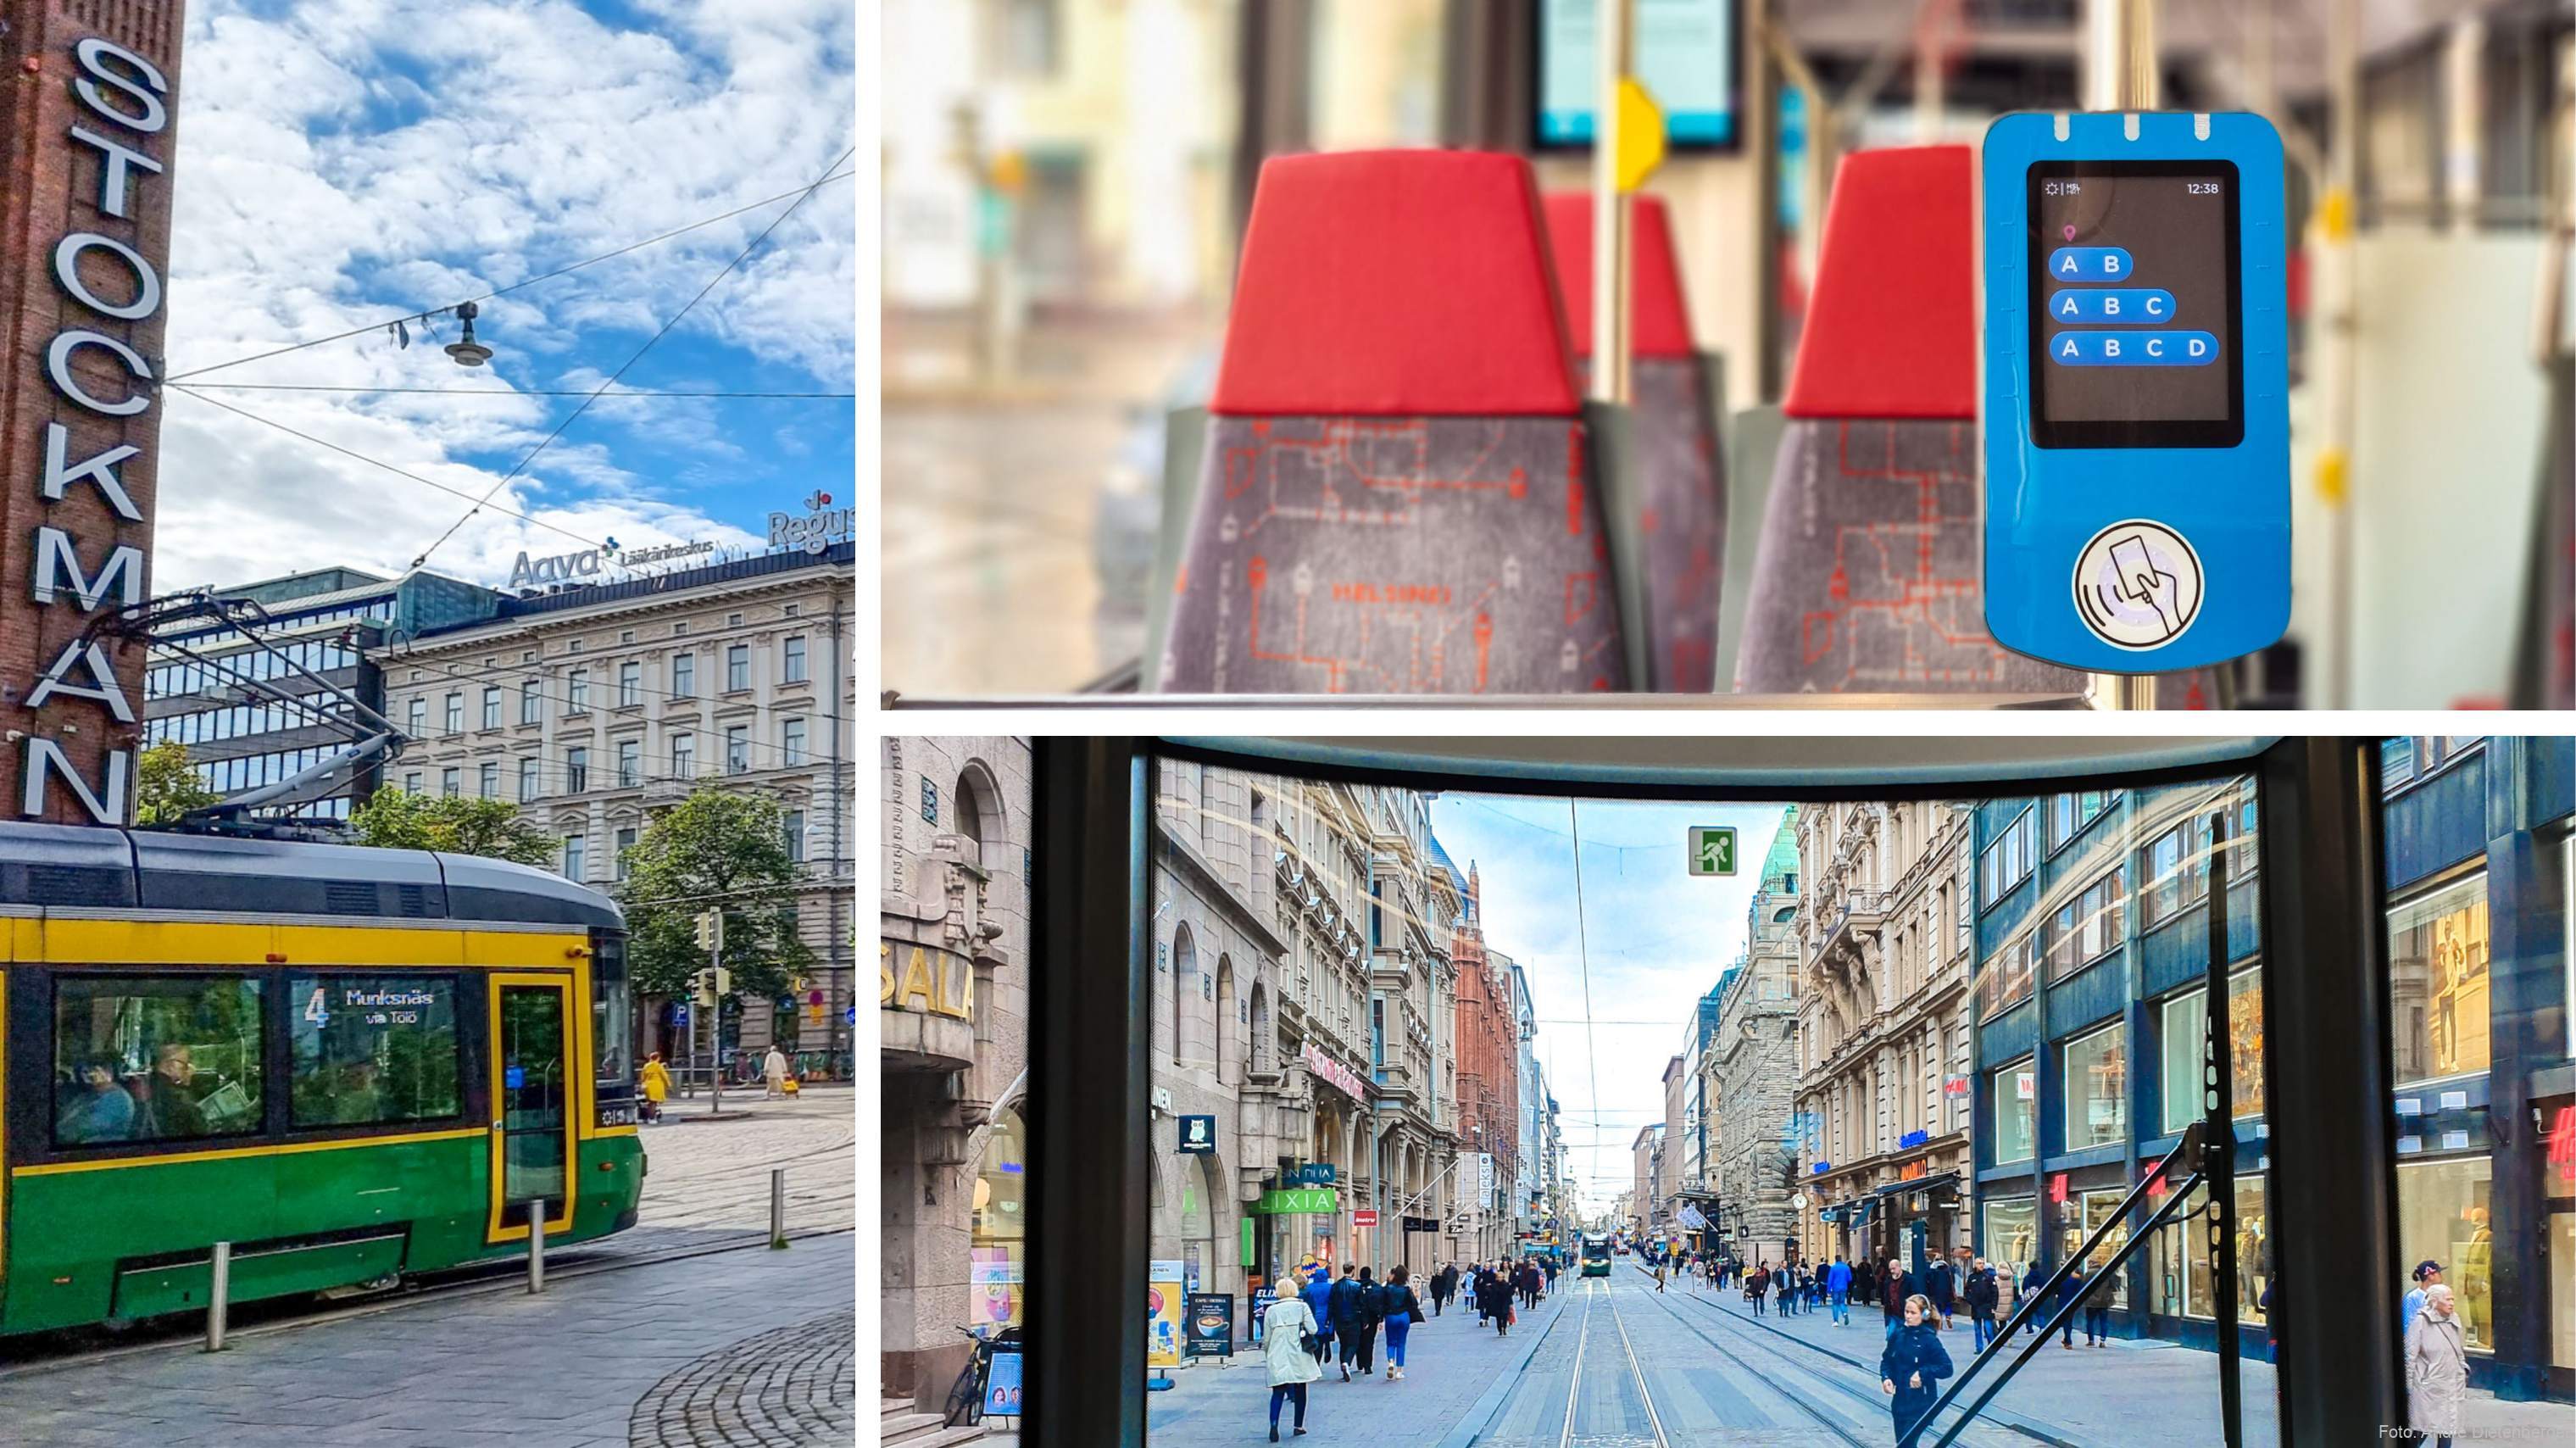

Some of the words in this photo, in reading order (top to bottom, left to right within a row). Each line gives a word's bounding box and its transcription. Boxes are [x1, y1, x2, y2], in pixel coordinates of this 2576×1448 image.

[2187, 183, 2219, 194] 12:38
[2061, 255, 2078, 272] A
[2105, 255, 2120, 272] B
[2061, 297, 2079, 315] A
[2106, 298, 2120, 315] B
[2145, 297, 2162, 315] C
[2062, 339, 2079, 356] A
[2106, 339, 2121, 356] B
[2146, 339, 2162, 356] C
[2189, 339, 2206, 356] D
[19, 36, 167, 826] STOCKMAN
[620, 540, 714, 567] Lääkärikeskus
[509, 549, 600, 588] Aava
[346, 989, 435, 1005] Munksnäs
[304, 988, 329, 1028] 4
[365, 1011, 387, 1024] via
